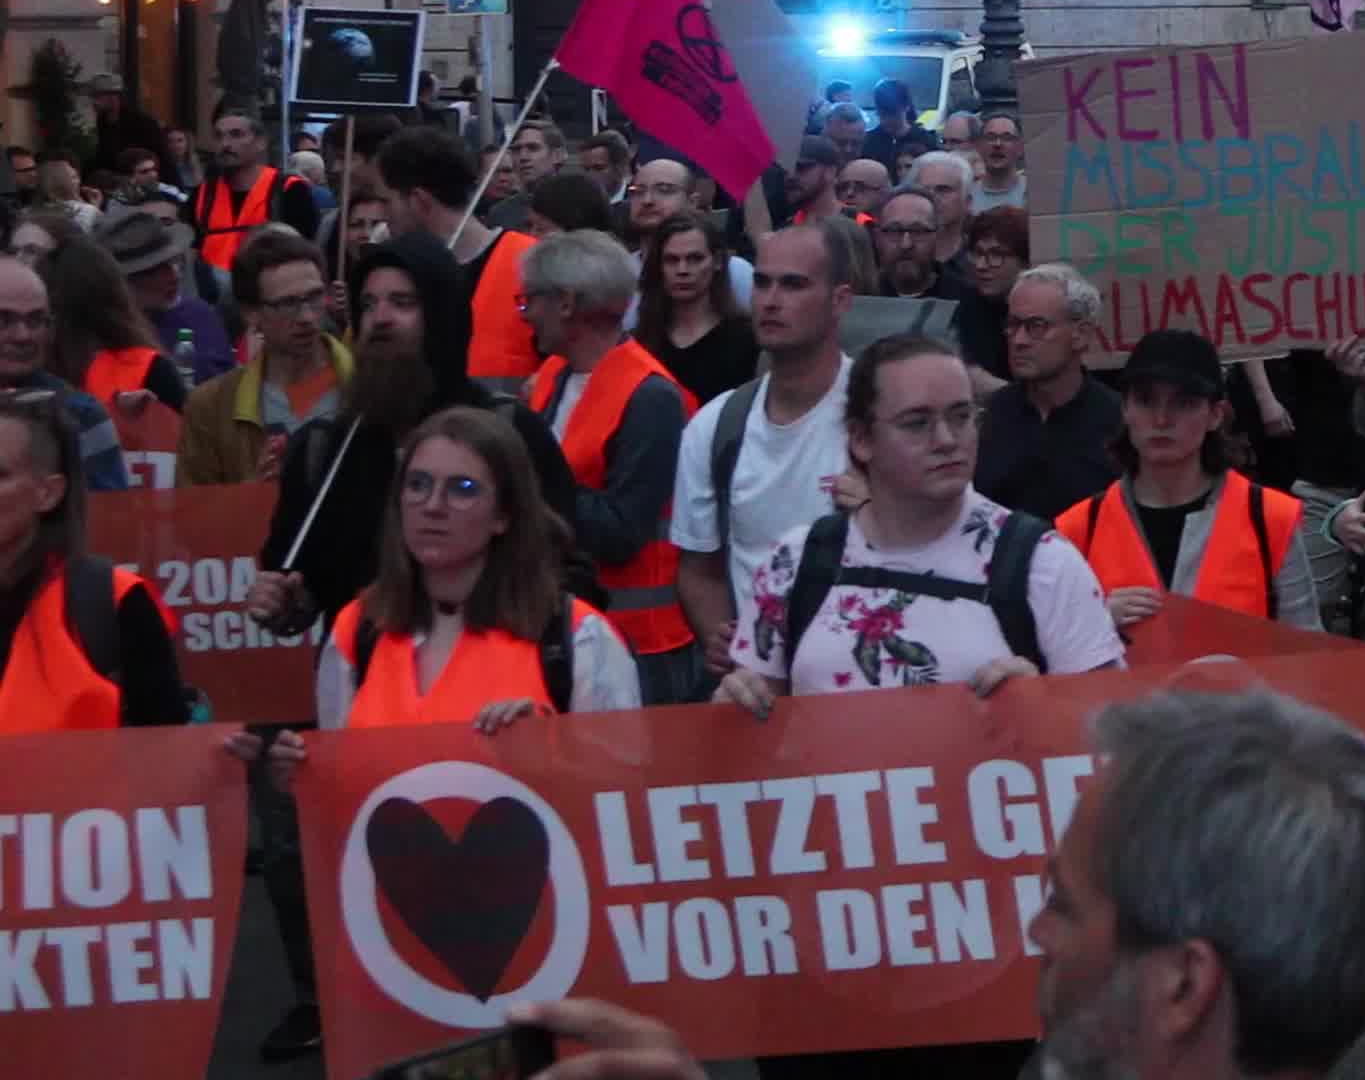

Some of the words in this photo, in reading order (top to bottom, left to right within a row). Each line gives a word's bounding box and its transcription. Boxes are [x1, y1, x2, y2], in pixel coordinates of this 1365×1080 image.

[1064, 44, 1250, 143] KEIN
[1056, 210, 1201, 274] DER
[594, 765, 948, 887] LETZTE
[608, 895, 799, 985] VOR
[818, 878, 995, 976] DEN
